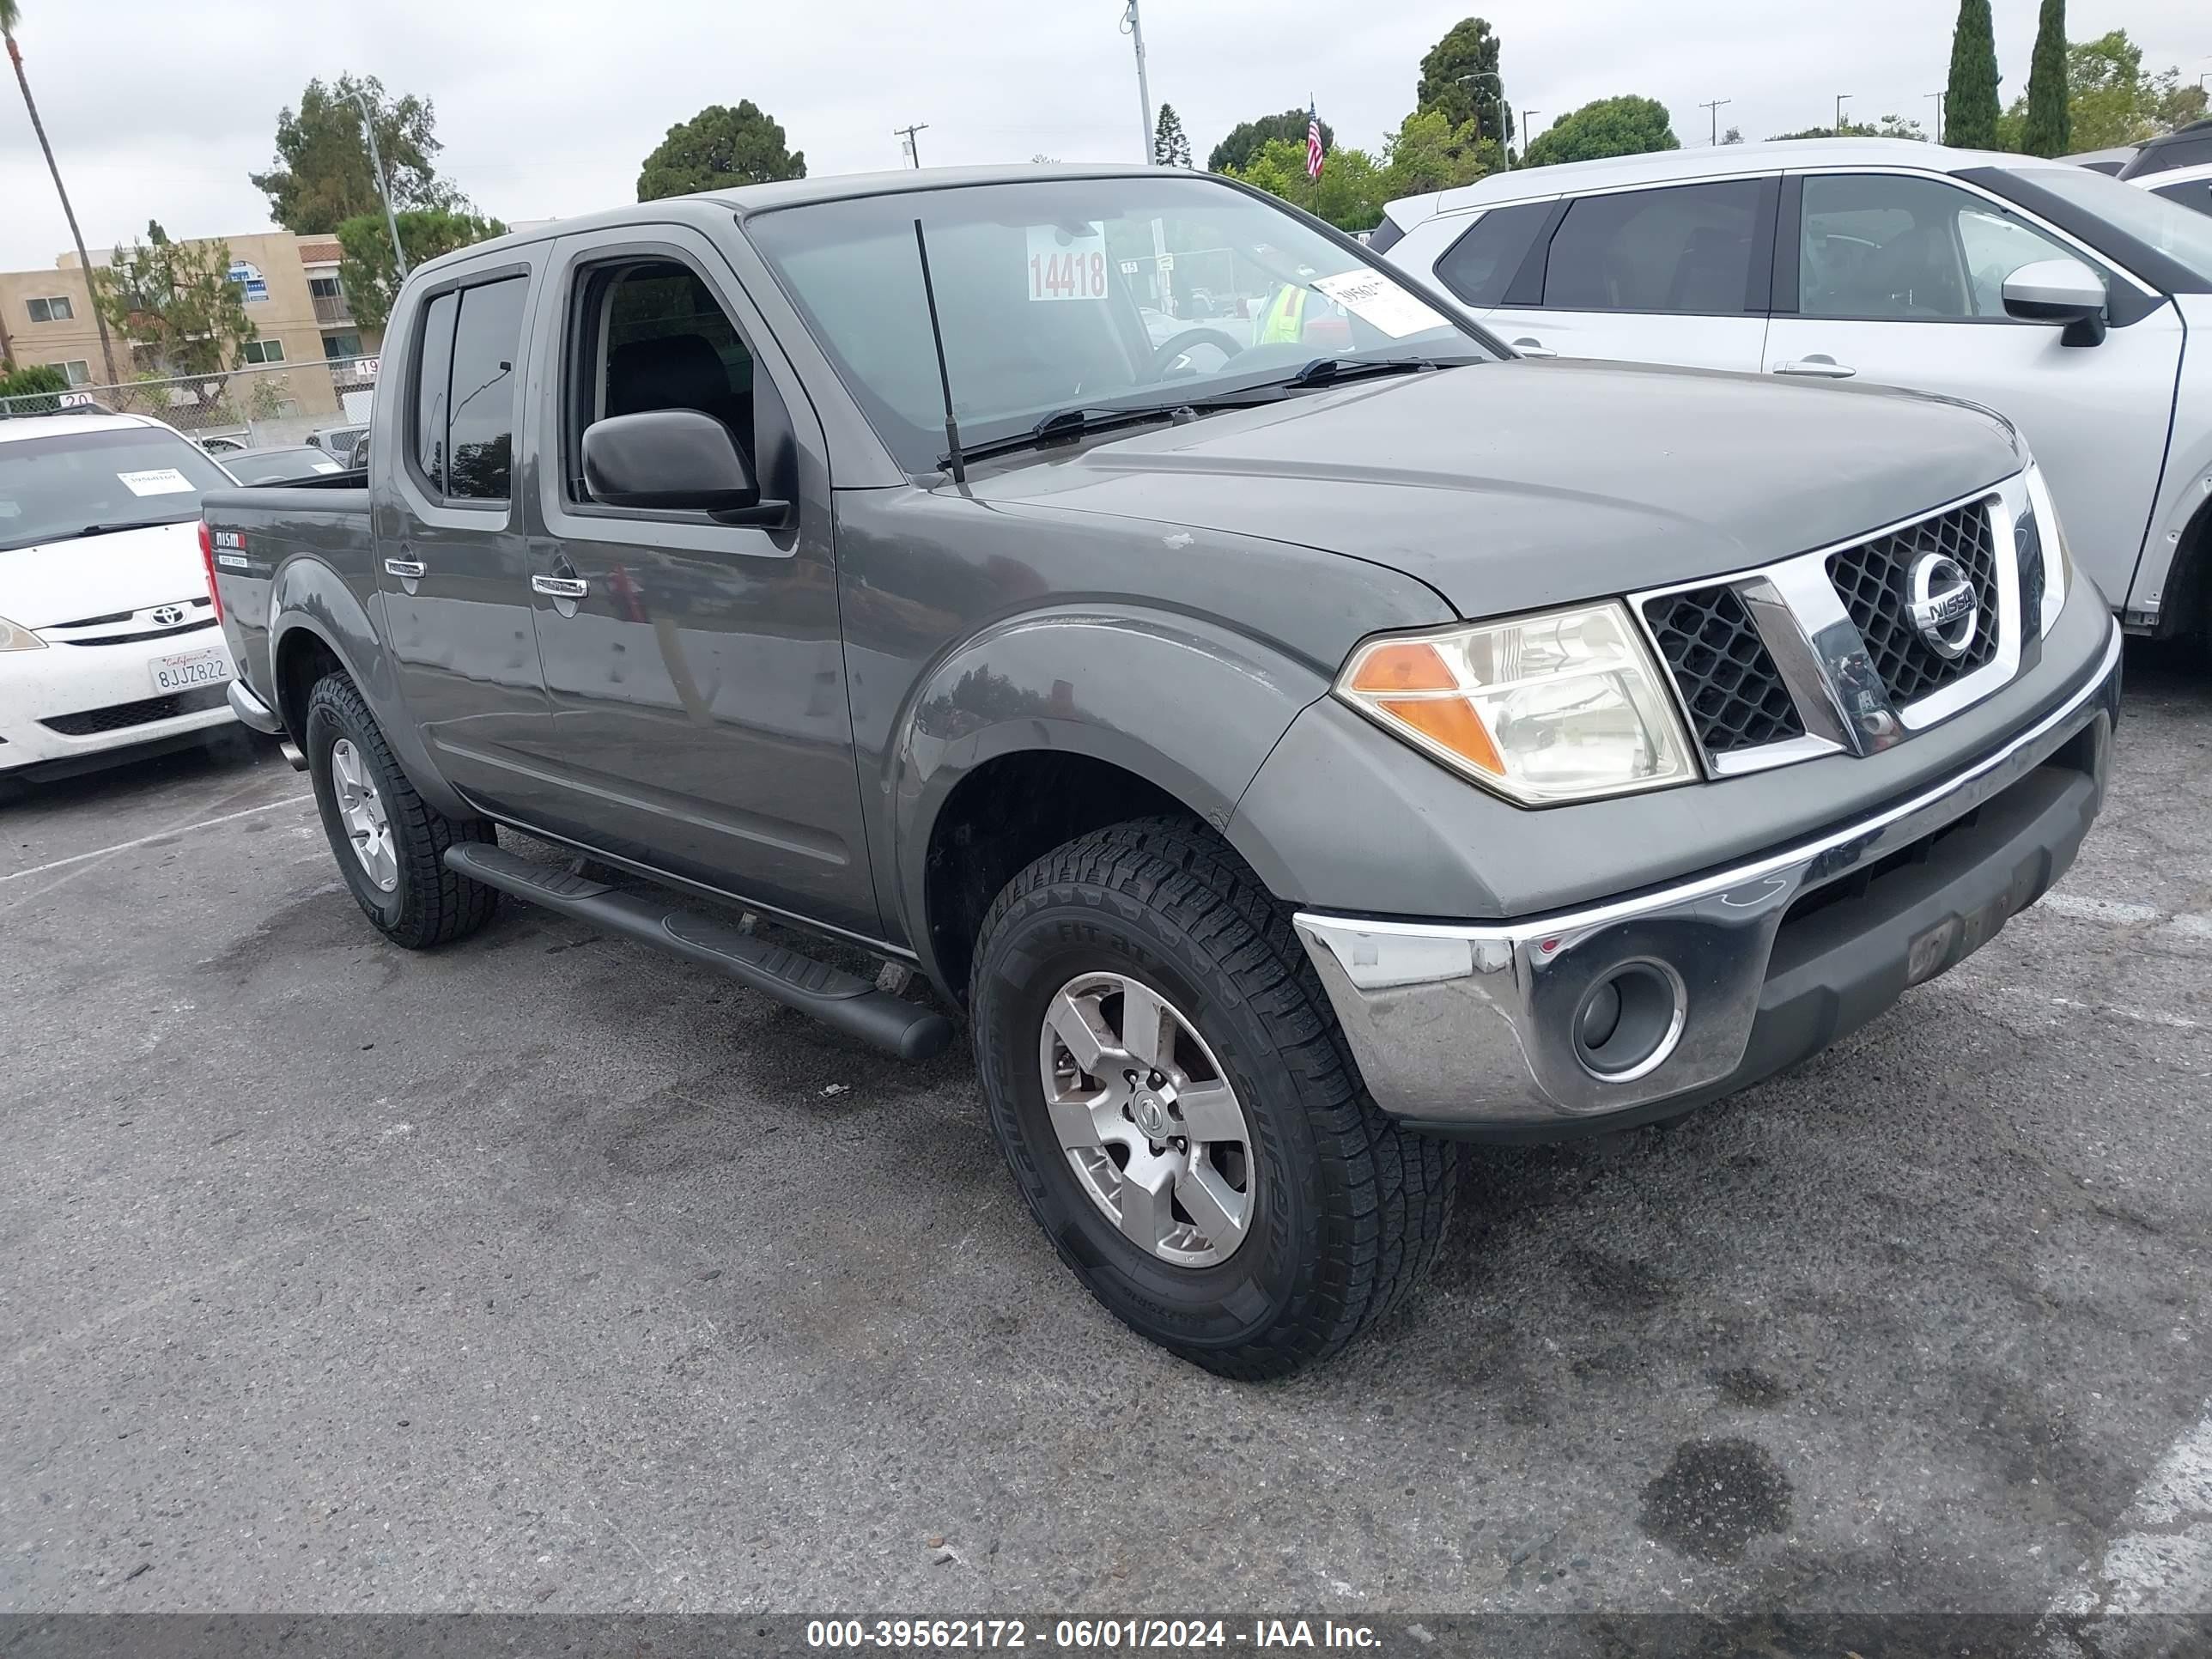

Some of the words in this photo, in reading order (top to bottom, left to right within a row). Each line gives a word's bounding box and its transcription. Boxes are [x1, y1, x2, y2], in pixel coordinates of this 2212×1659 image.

[1030, 252, 1105, 297] 14418
[1336, 282, 1383, 302] 39562
[361, 361, 378, 373] 19
[166, 653, 208, 667] California
[158, 659, 228, 688] 8JJZ822
